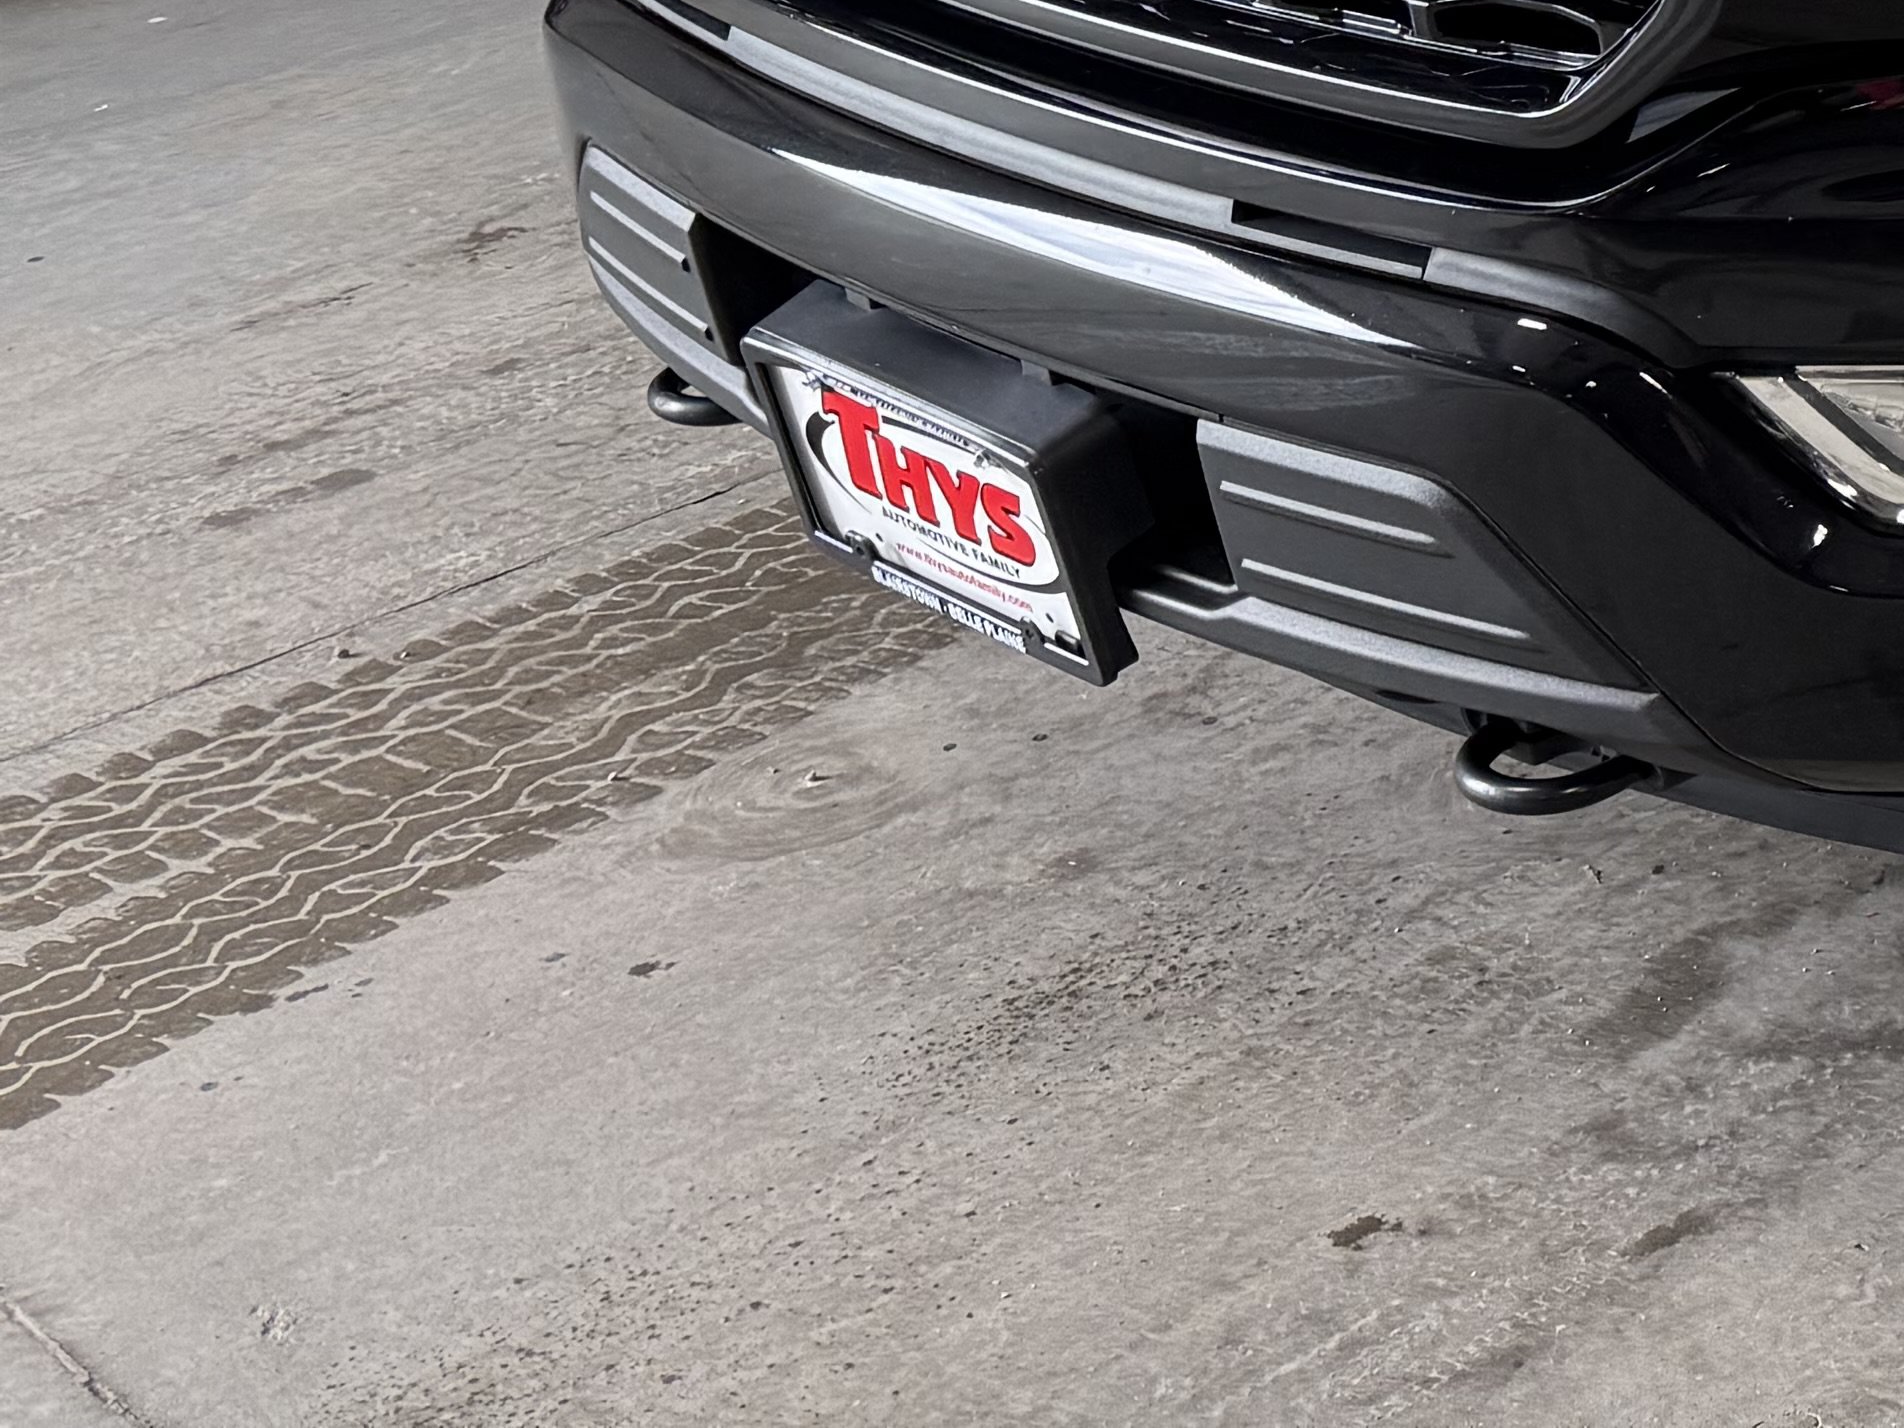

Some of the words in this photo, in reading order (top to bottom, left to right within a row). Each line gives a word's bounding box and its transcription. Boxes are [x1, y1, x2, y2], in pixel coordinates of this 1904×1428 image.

[821, 388, 1036, 568] THYS
[882, 505, 969, 557] AUTOMOTIVE
[972, 548, 1021, 579] FAMILY
